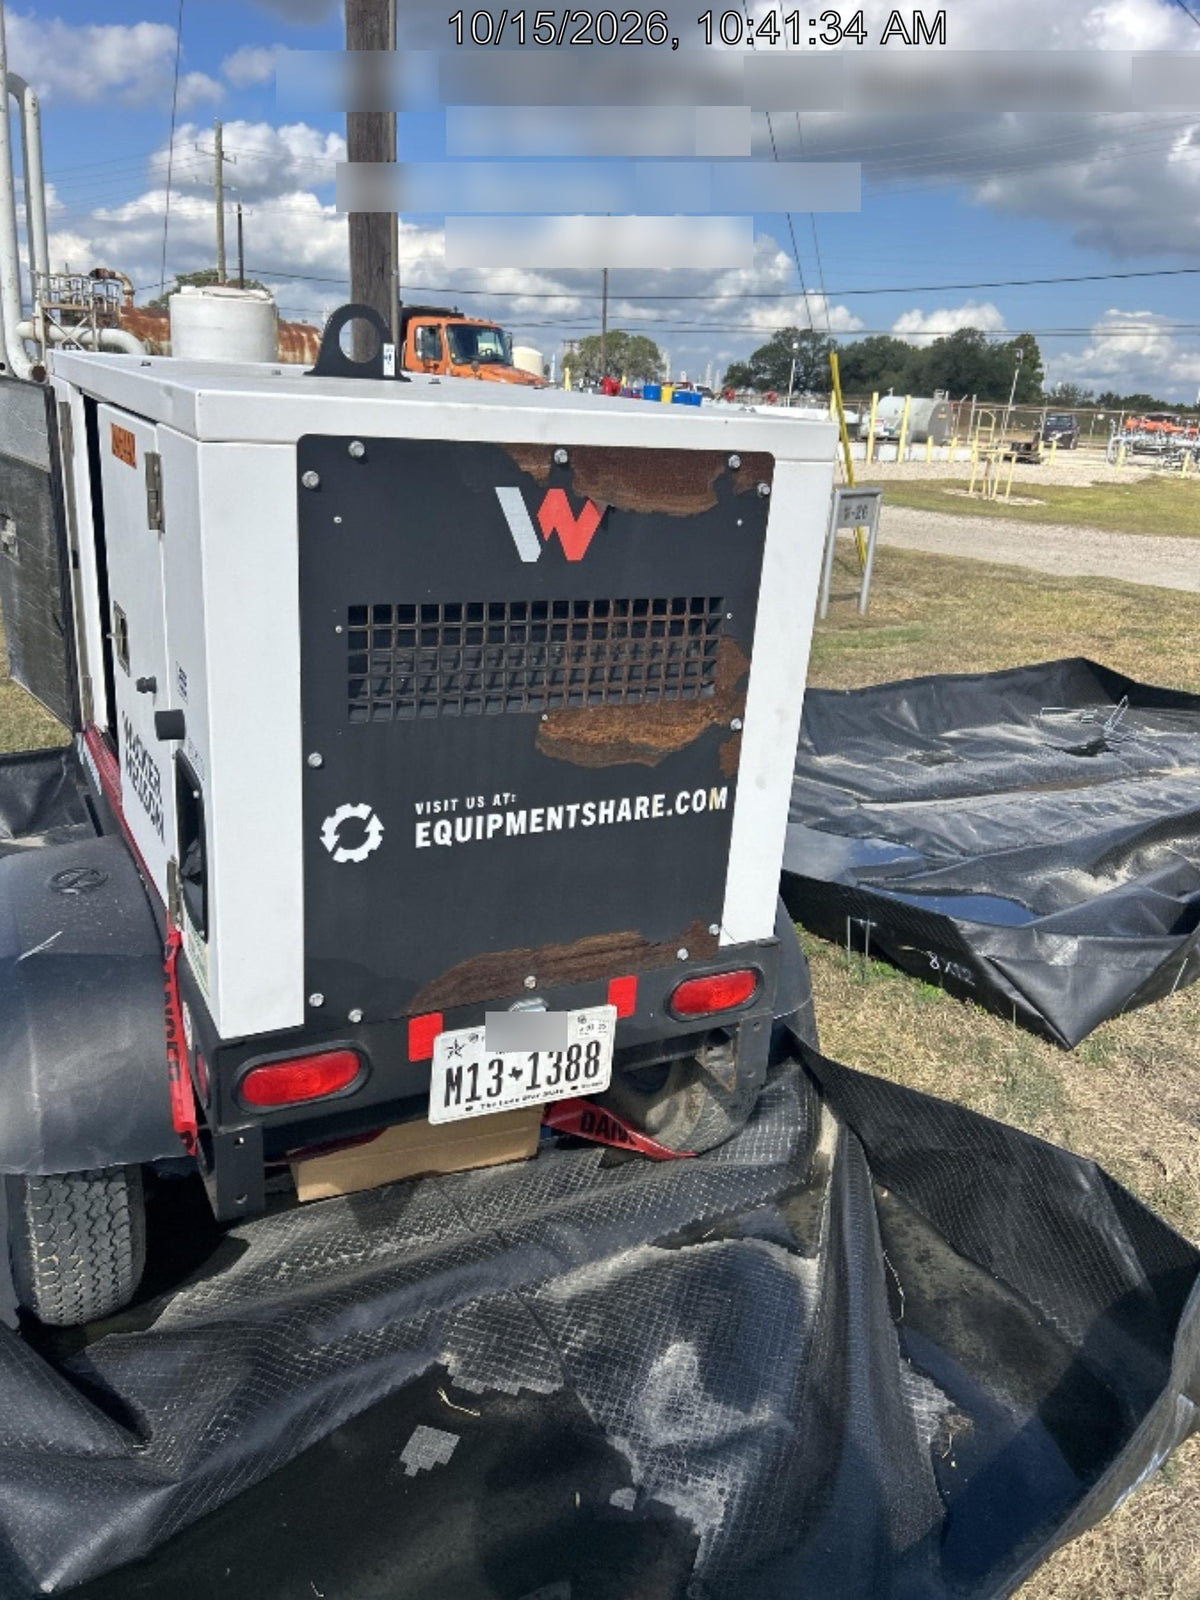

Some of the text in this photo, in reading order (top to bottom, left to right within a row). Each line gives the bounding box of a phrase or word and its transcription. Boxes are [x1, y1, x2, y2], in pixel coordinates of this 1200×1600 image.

[414, 792, 518, 815] VISIT US AT:
[415, 786, 728, 849] EQUIPMENTSHARE.COM
